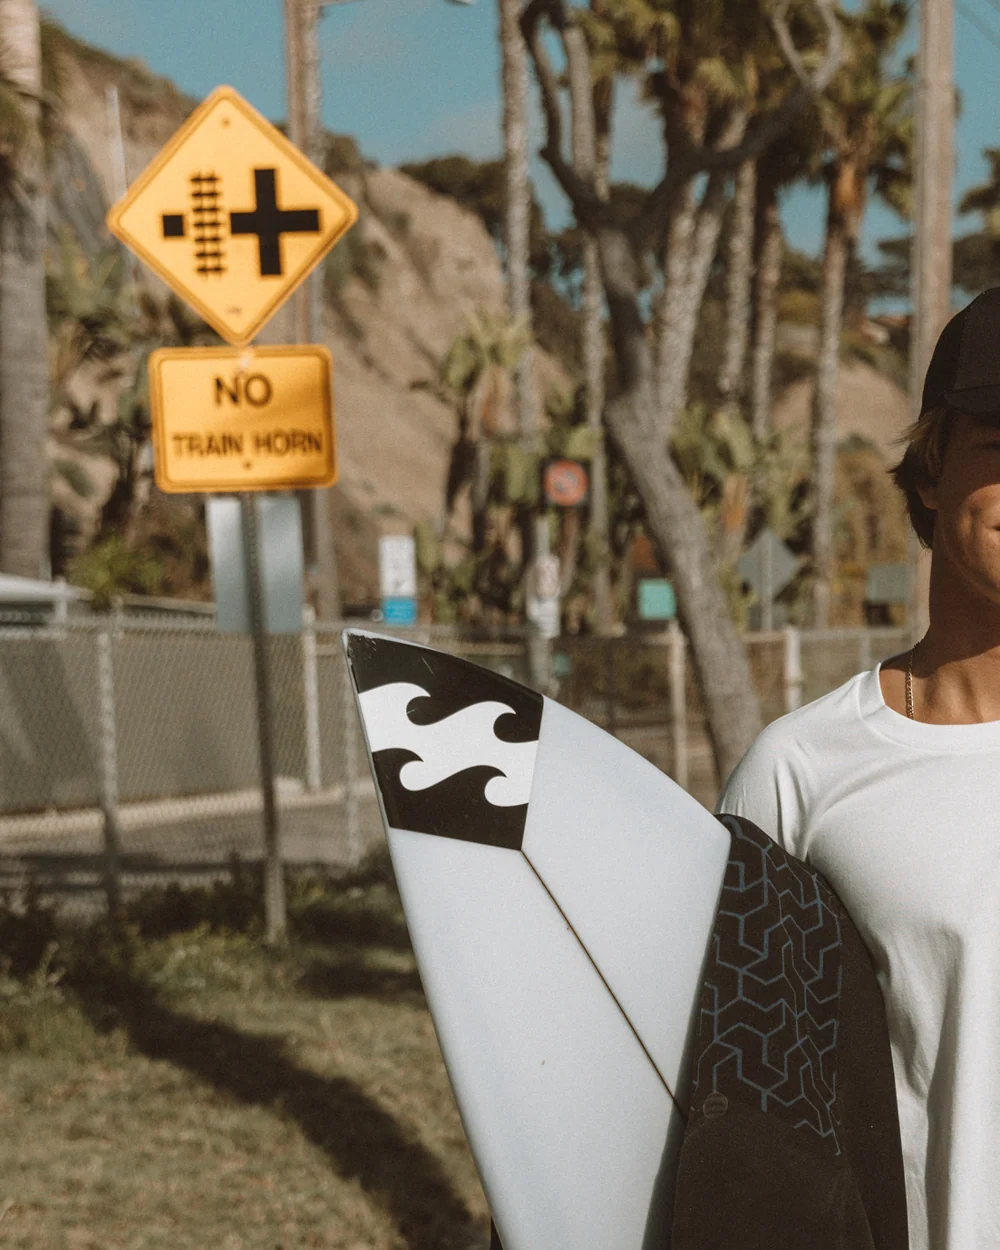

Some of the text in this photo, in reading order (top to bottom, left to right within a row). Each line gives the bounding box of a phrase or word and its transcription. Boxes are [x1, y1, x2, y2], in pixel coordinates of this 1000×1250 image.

[214, 373, 273, 408] NO
[172, 429, 323, 457] TRAIN HORN
